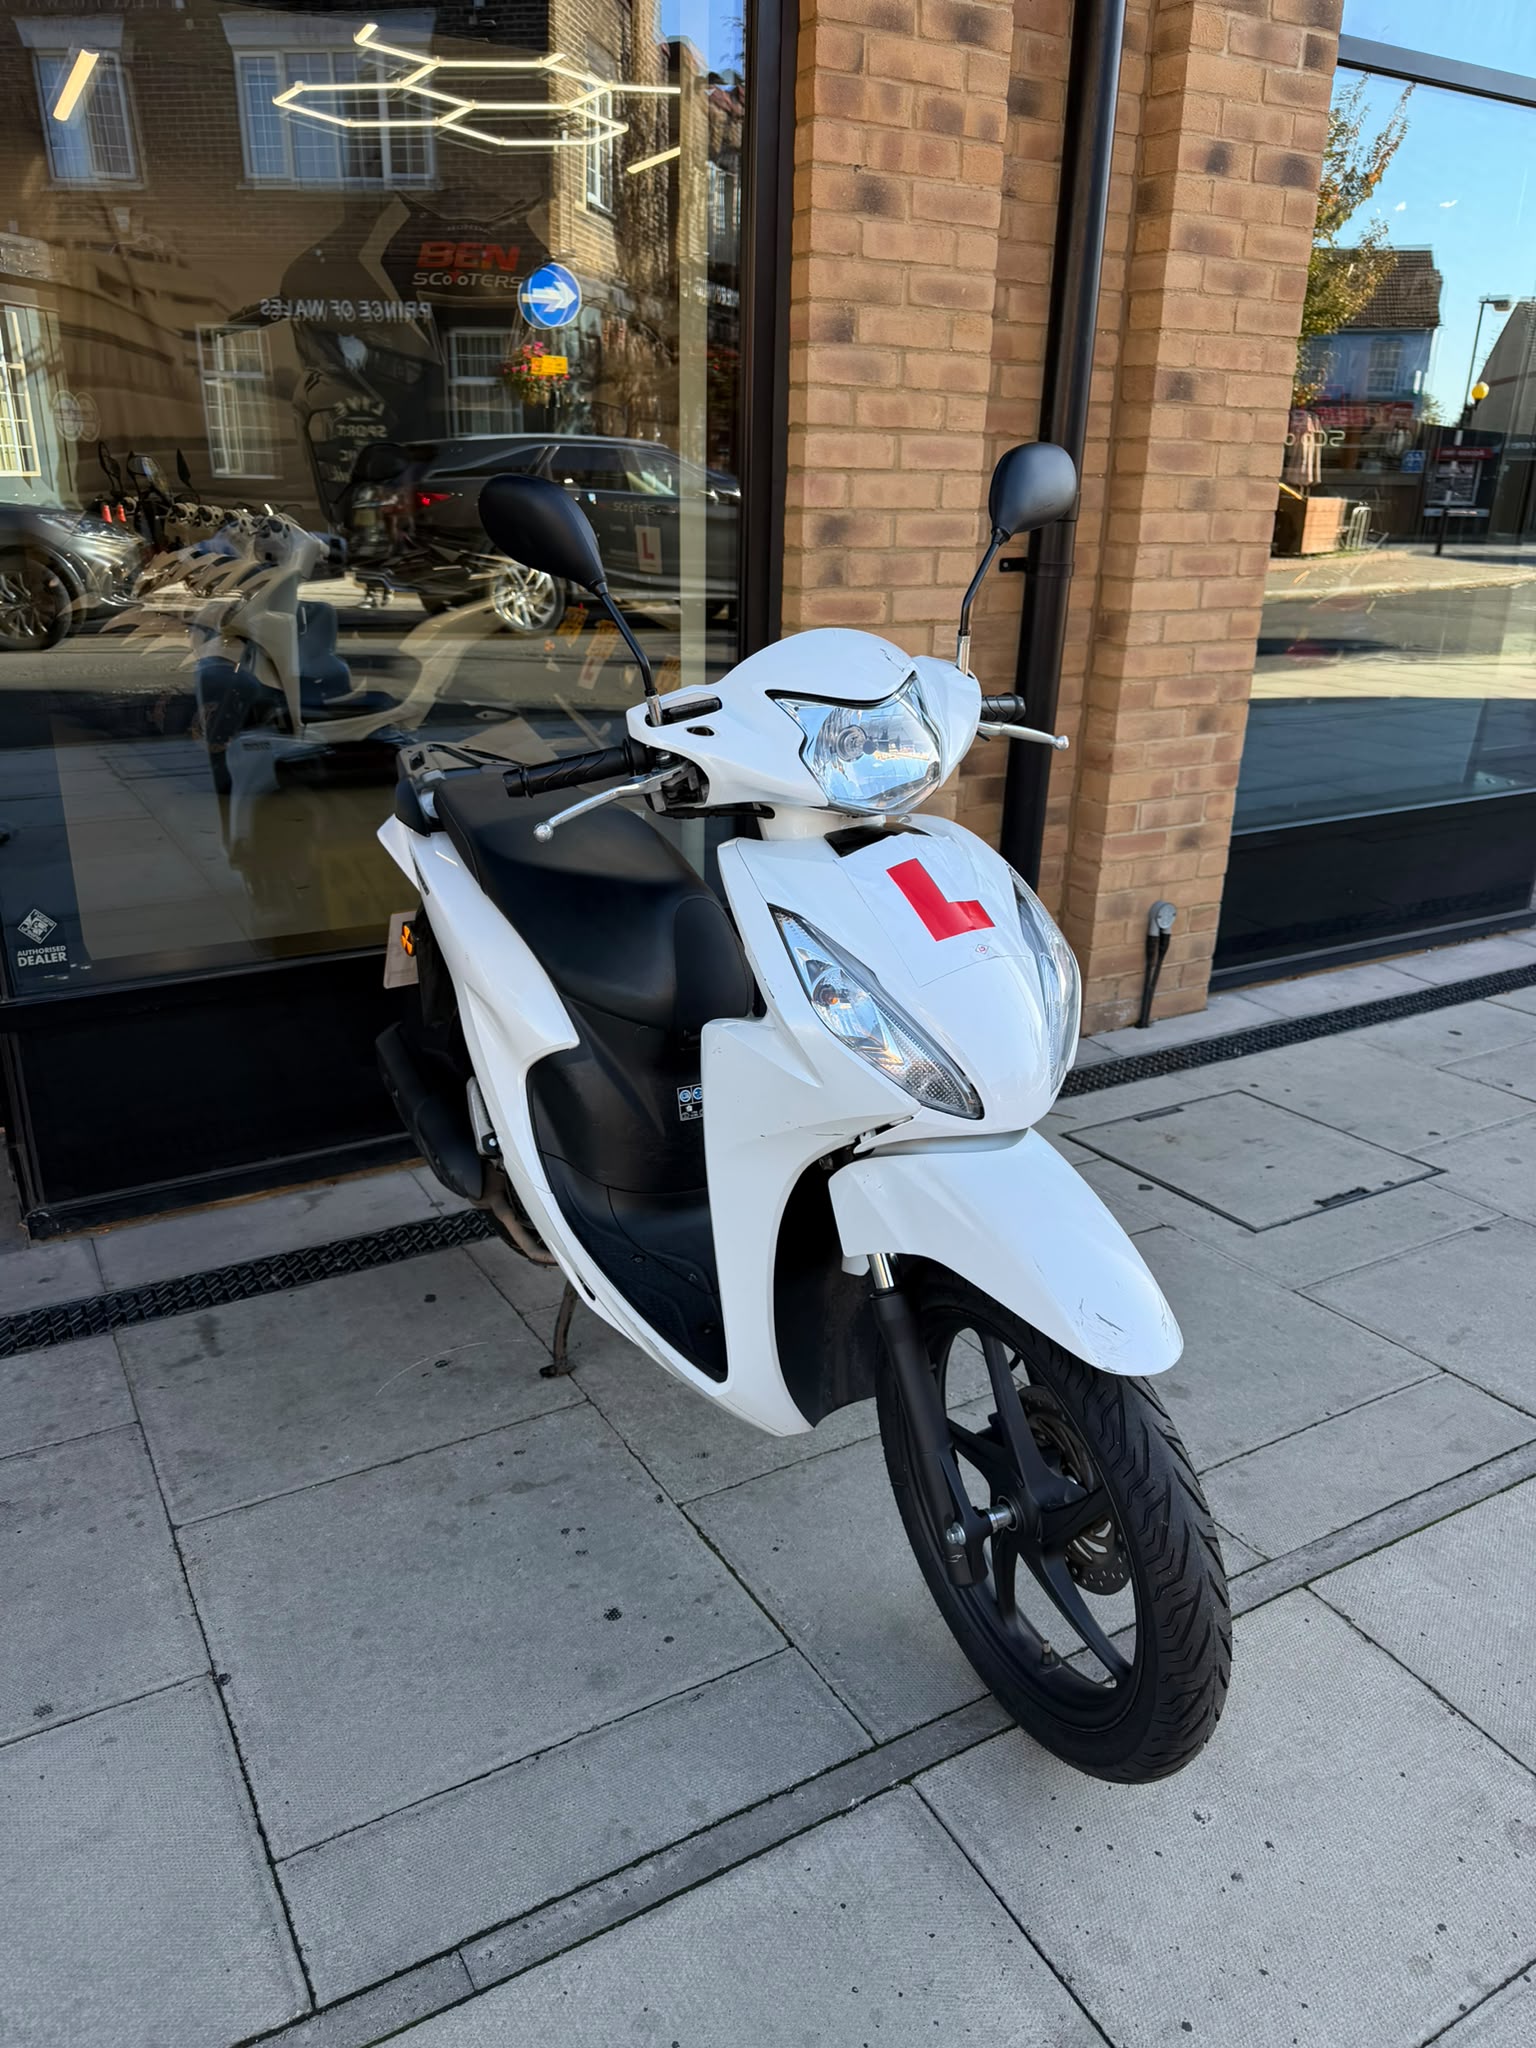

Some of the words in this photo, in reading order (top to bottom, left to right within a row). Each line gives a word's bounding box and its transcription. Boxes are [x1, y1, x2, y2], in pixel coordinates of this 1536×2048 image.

[417, 241, 520, 271] BEN
[641, 532, 655, 560] L
[885, 857, 996, 942] L
[17, 945, 67, 957] AUTHORISED
[17, 951, 68, 968] DEALER
